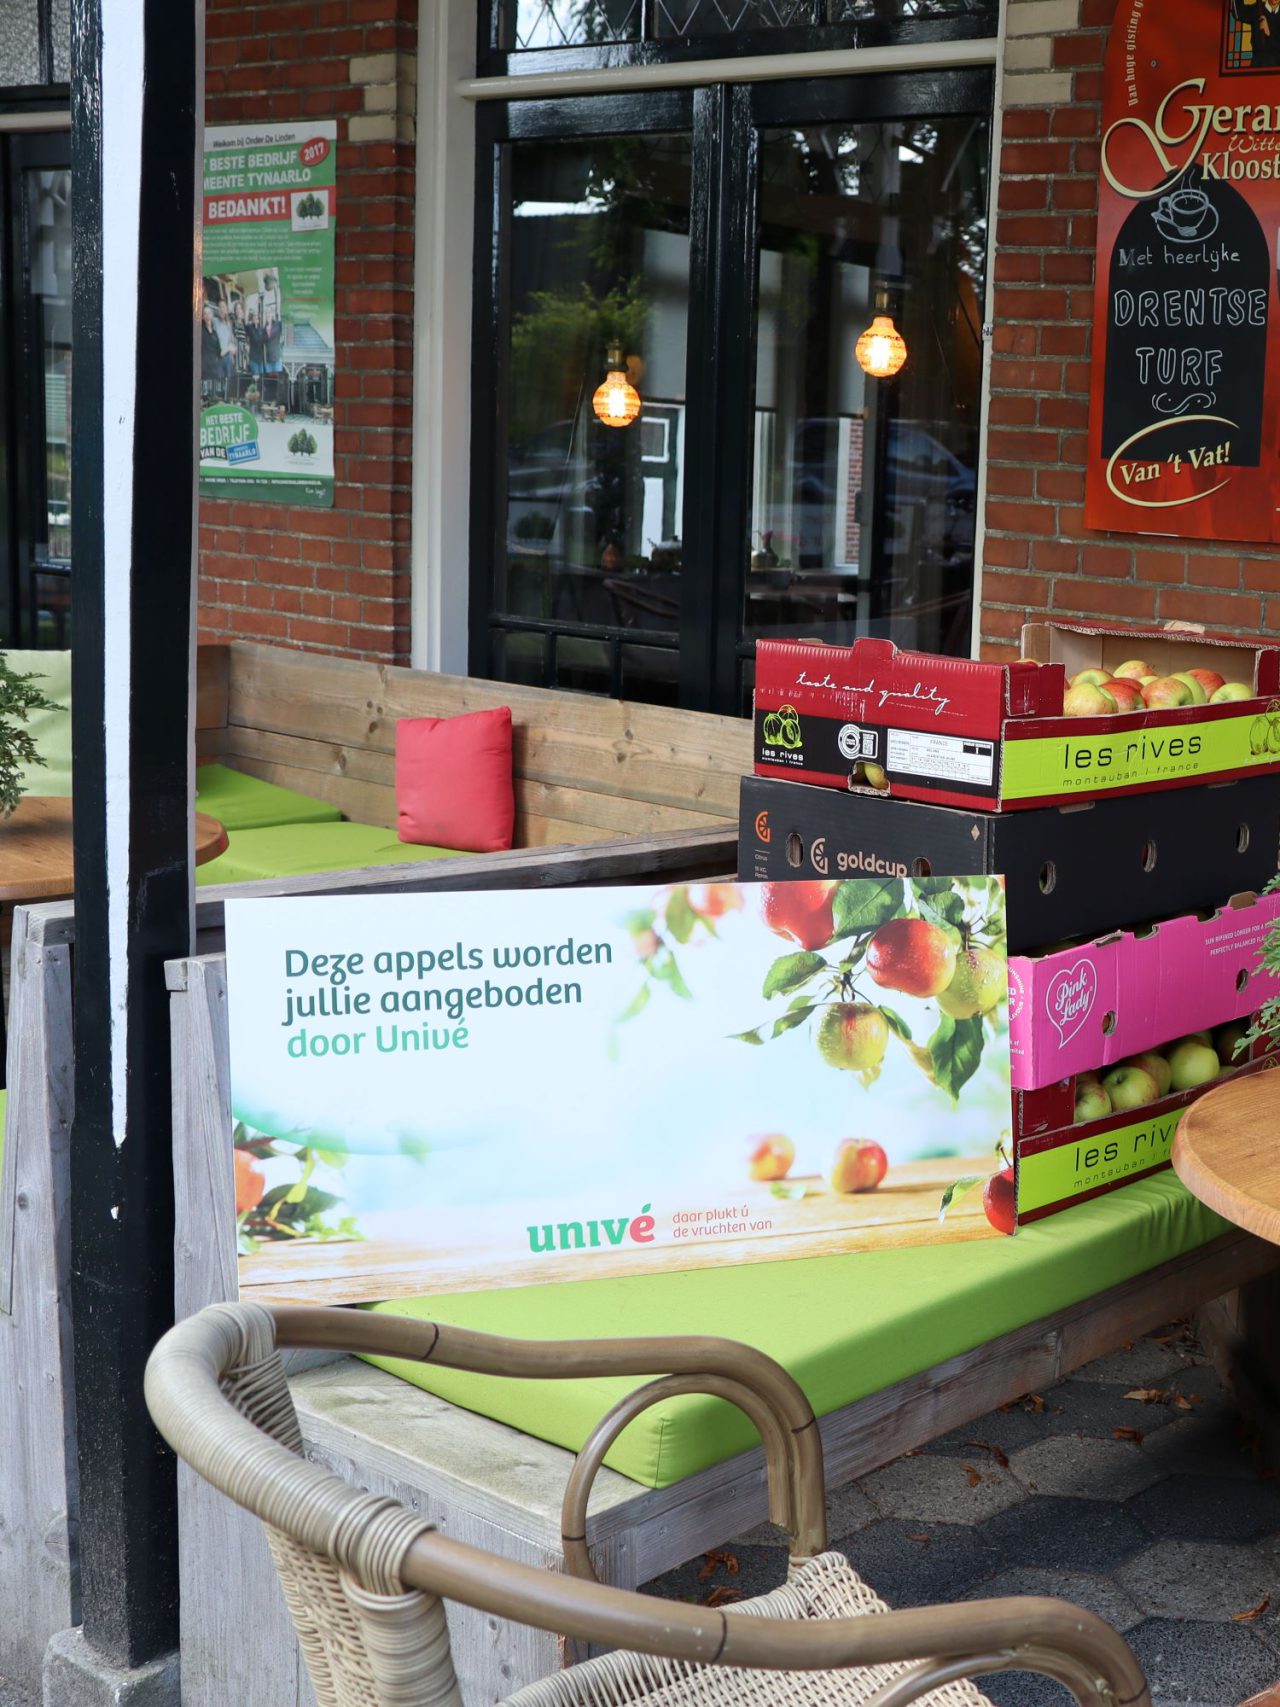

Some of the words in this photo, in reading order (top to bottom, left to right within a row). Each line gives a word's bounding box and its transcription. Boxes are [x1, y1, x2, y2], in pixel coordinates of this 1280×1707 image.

[245, 135, 264, 144] Onder
[275, 133, 296, 142] Linden
[304, 142, 324, 161] 2017
[210, 156, 245, 171] BESTE
[248, 151, 297, 167] BEDRIJF
[204, 174, 244, 190] MEENTE
[247, 168, 311, 186] TYNAARLO
[208, 196, 286, 219] BEDANKT!
[1119, 247, 1153, 267] Met
[1114, 287, 1267, 327] DRENTSE
[1136, 347, 1223, 386] TURF
[219, 412, 244, 424] BESTE
[200, 424, 249, 446] BEDRIJF
[200, 447, 215, 458] VAN
[216, 448, 226, 457] DE
[1120, 462, 1160, 486] Van
[1188, 440, 1231, 470] Vat!
[795, 671, 837, 689] taste
[842, 679, 874, 693] and
[878, 682, 950, 716] quality
[762, 748, 776, 757] les
[780, 750, 803, 761] rives
[1064, 744, 1112, 769] les
[1126, 735, 1201, 762] rives
[1063, 771, 1137, 787] montauban
[1157, 762, 1199, 775] france
[836, 851, 908, 878] goldcup
[285, 949, 364, 986] Deze
[373, 942, 484, 981] appels
[492, 937, 613, 969] worden
[281, 985, 372, 1027] jullie
[380, 977, 582, 1020] aangeboden
[1055, 967, 1088, 1011] Pink
[1060, 988, 1090, 1026] Lady
[287, 1028, 366, 1059] door
[375, 1016, 470, 1055] Univé
[1076, 1142, 1119, 1172] les
[1134, 1123, 1178, 1153] riv
[1074, 1158, 1145, 1188] montauban
[527, 1203, 656, 1253] univé
[672, 1208, 702, 1224] daar
[705, 1206, 738, 1223] plukt
[673, 1224, 688, 1239] de
[691, 1220, 747, 1237] vruchten
[750, 1218, 772, 1231] van
